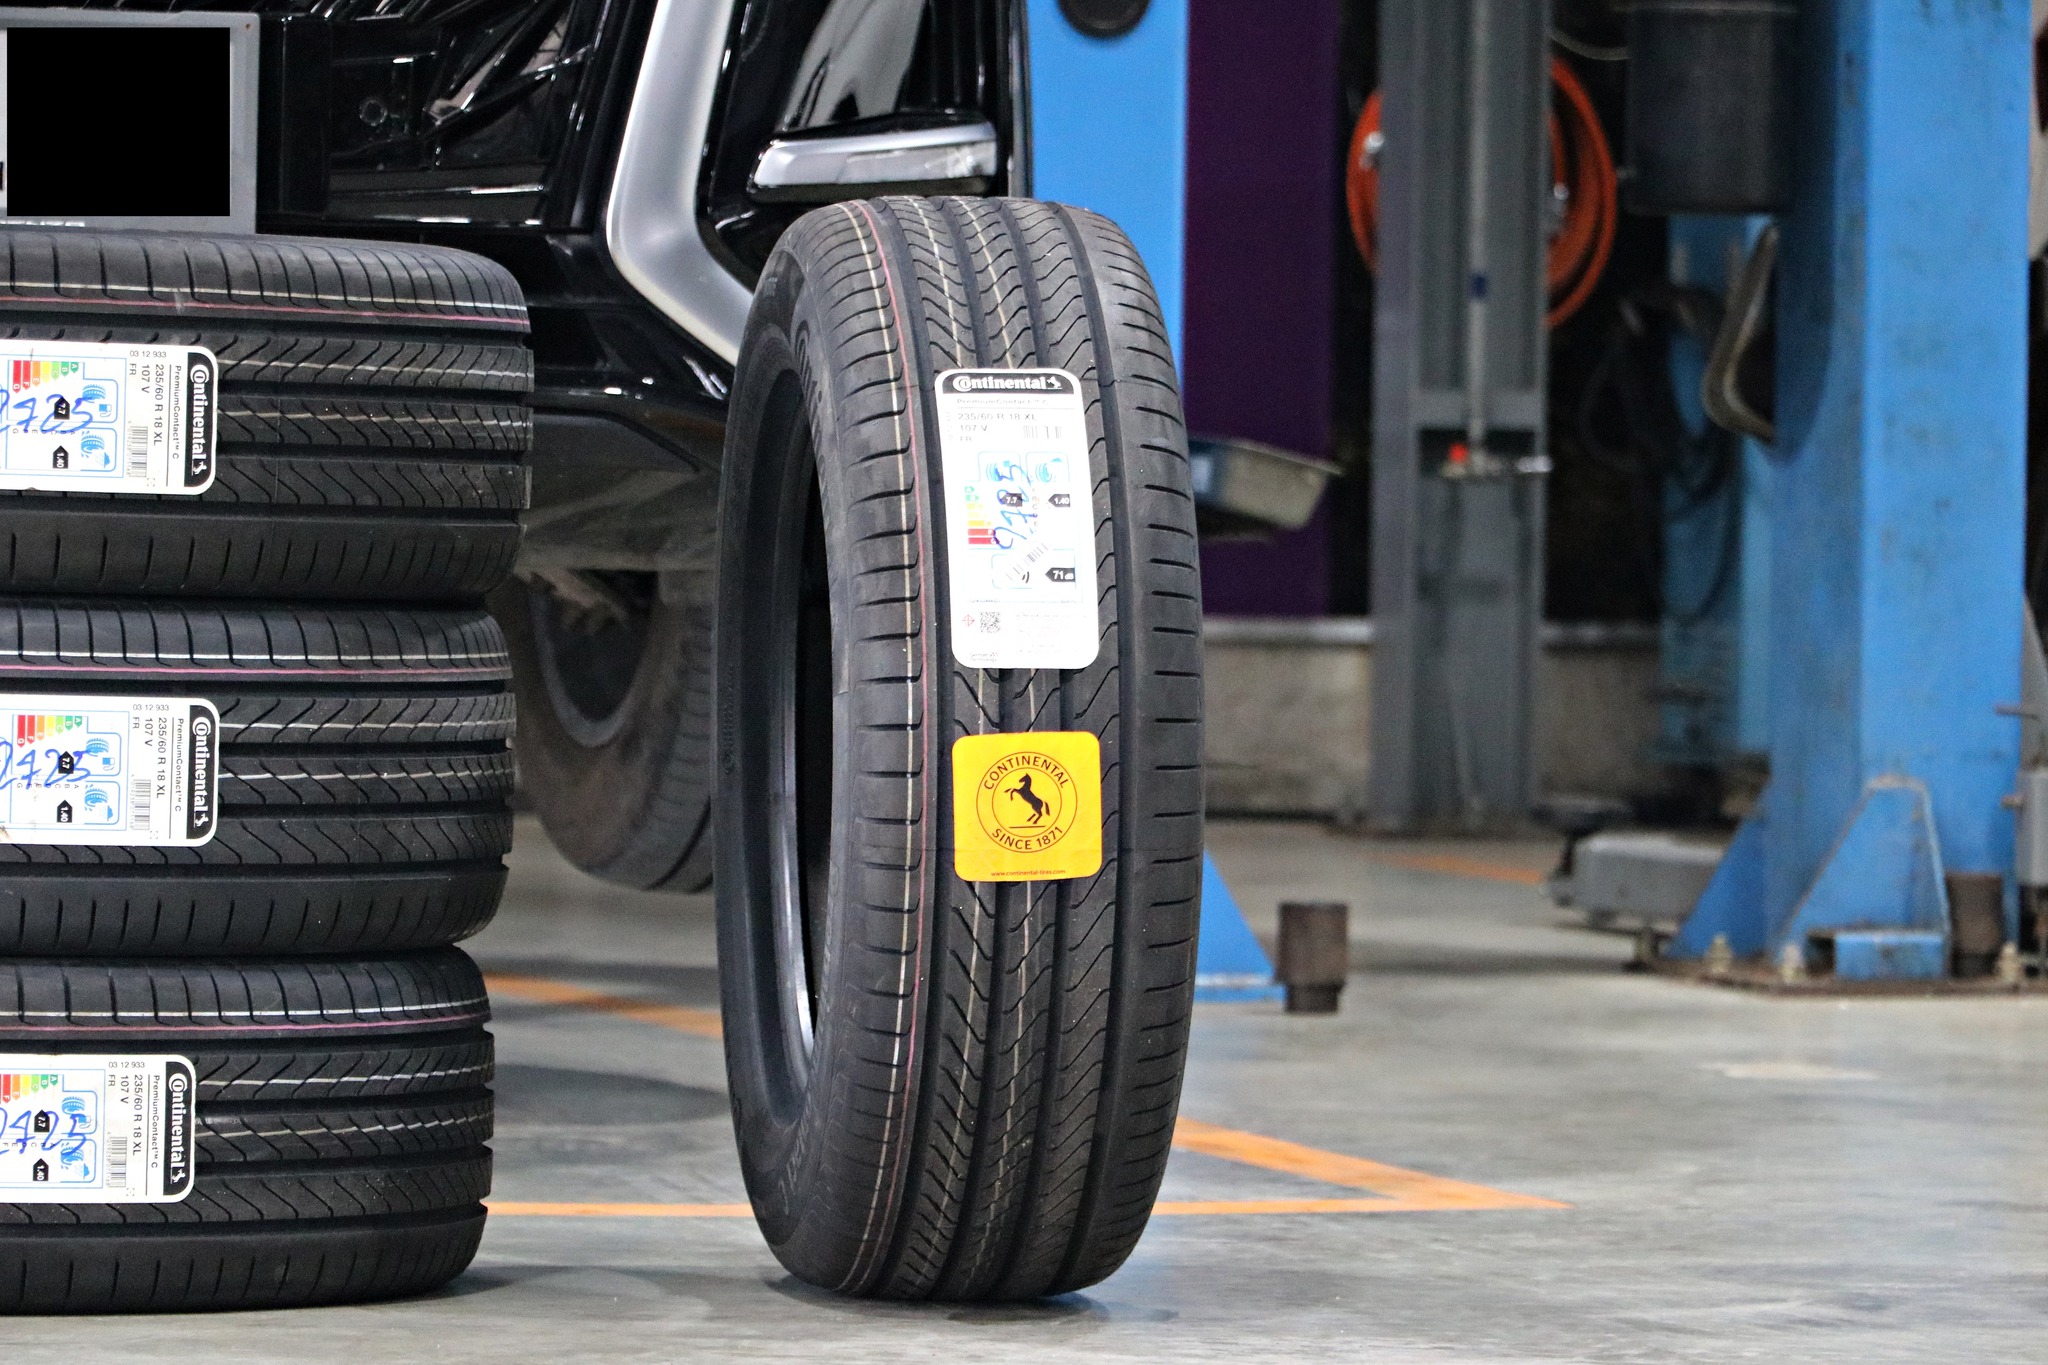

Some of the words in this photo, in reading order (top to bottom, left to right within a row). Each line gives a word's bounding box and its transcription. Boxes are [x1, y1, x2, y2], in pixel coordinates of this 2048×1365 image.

[130, 363, 137, 376] FR
[142, 364, 150, 383] 107
[154, 364, 164, 400] 235/60
[953, 376, 1046, 392] Continental
[142, 386, 150, 394] V
[154, 404, 164, 412] R
[190, 364, 210, 460] Continental
[154, 417, 163, 428] 18
[958, 412, 994, 421] 235/60
[154, 432, 162, 446] XL
[1054, 497, 1069, 505] 1.40
[132, 716, 140, 729] FR
[144, 718, 153, 736] 107
[158, 718, 167, 753] 235/60
[158, 757, 166, 765] R
[192, 716, 211, 812] Continental
[157, 770, 166, 780] 18
[984, 756, 1068, 790] CONTINENTAL
[156, 785, 165, 798] XL
[992, 828, 1032, 850] SINCE
[1036, 826, 1063, 848] 1871
[108, 1074, 116, 1087] FR
[120, 1075, 129, 1093] 107
[134, 1074, 143, 1110] 235/60
[134, 1114, 142, 1122] R
[168, 1073, 188, 1168] Continental
[133, 1127, 142, 1138] 18
[132, 1142, 142, 1156] XL
[36, 1164, 44, 1181] 1.40
